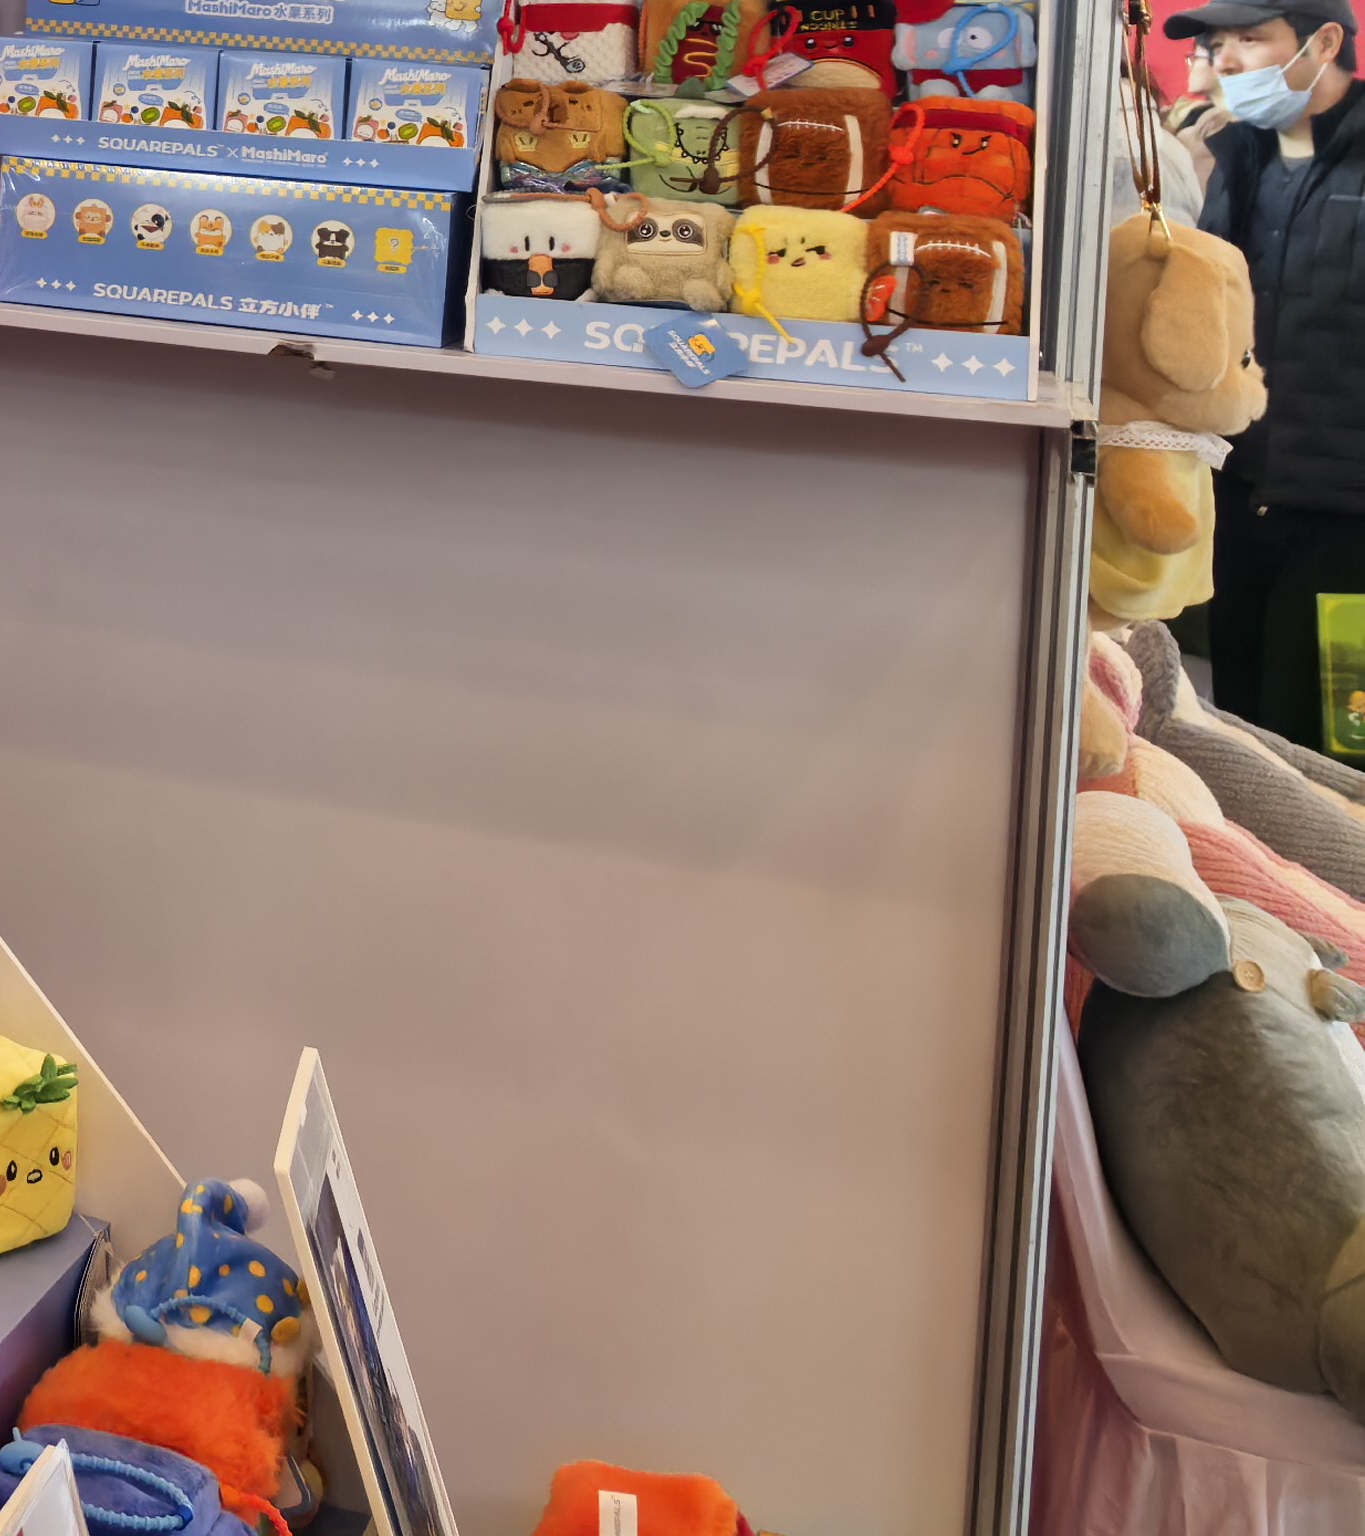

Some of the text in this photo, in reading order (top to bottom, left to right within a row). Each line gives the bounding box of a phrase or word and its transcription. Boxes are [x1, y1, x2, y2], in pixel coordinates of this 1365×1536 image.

[810, 8, 845, 21] CUP
[241, 145, 327, 163] MashiMaro
[93, 282, 233, 311] SQUAREPALS
